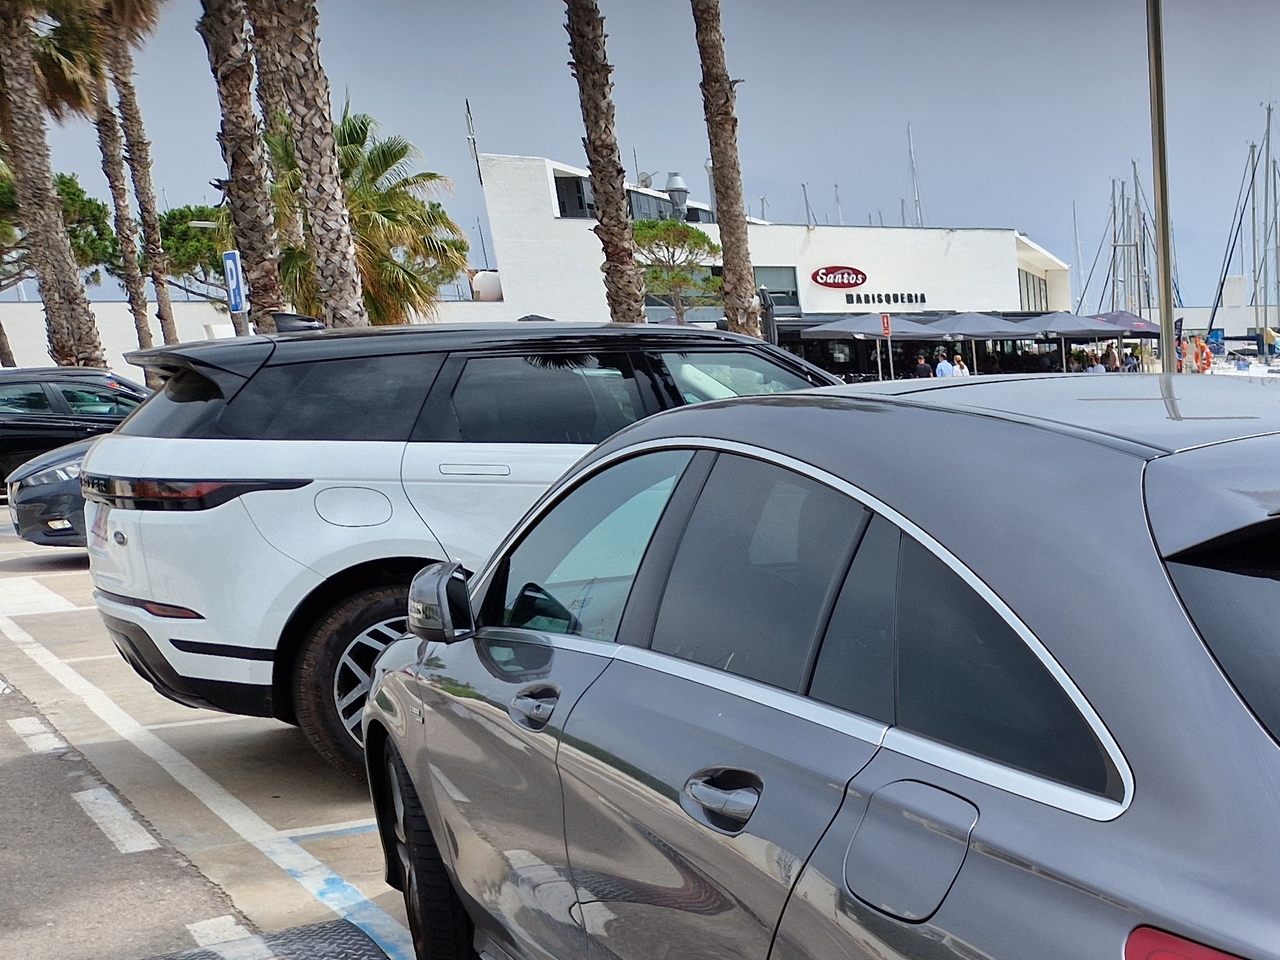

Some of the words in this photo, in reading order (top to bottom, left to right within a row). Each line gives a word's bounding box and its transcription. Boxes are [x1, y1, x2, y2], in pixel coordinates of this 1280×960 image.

[226, 259, 237, 305] P
[816, 268, 863, 284] Santos
[845, 292, 927, 305] MARISQUERIA
